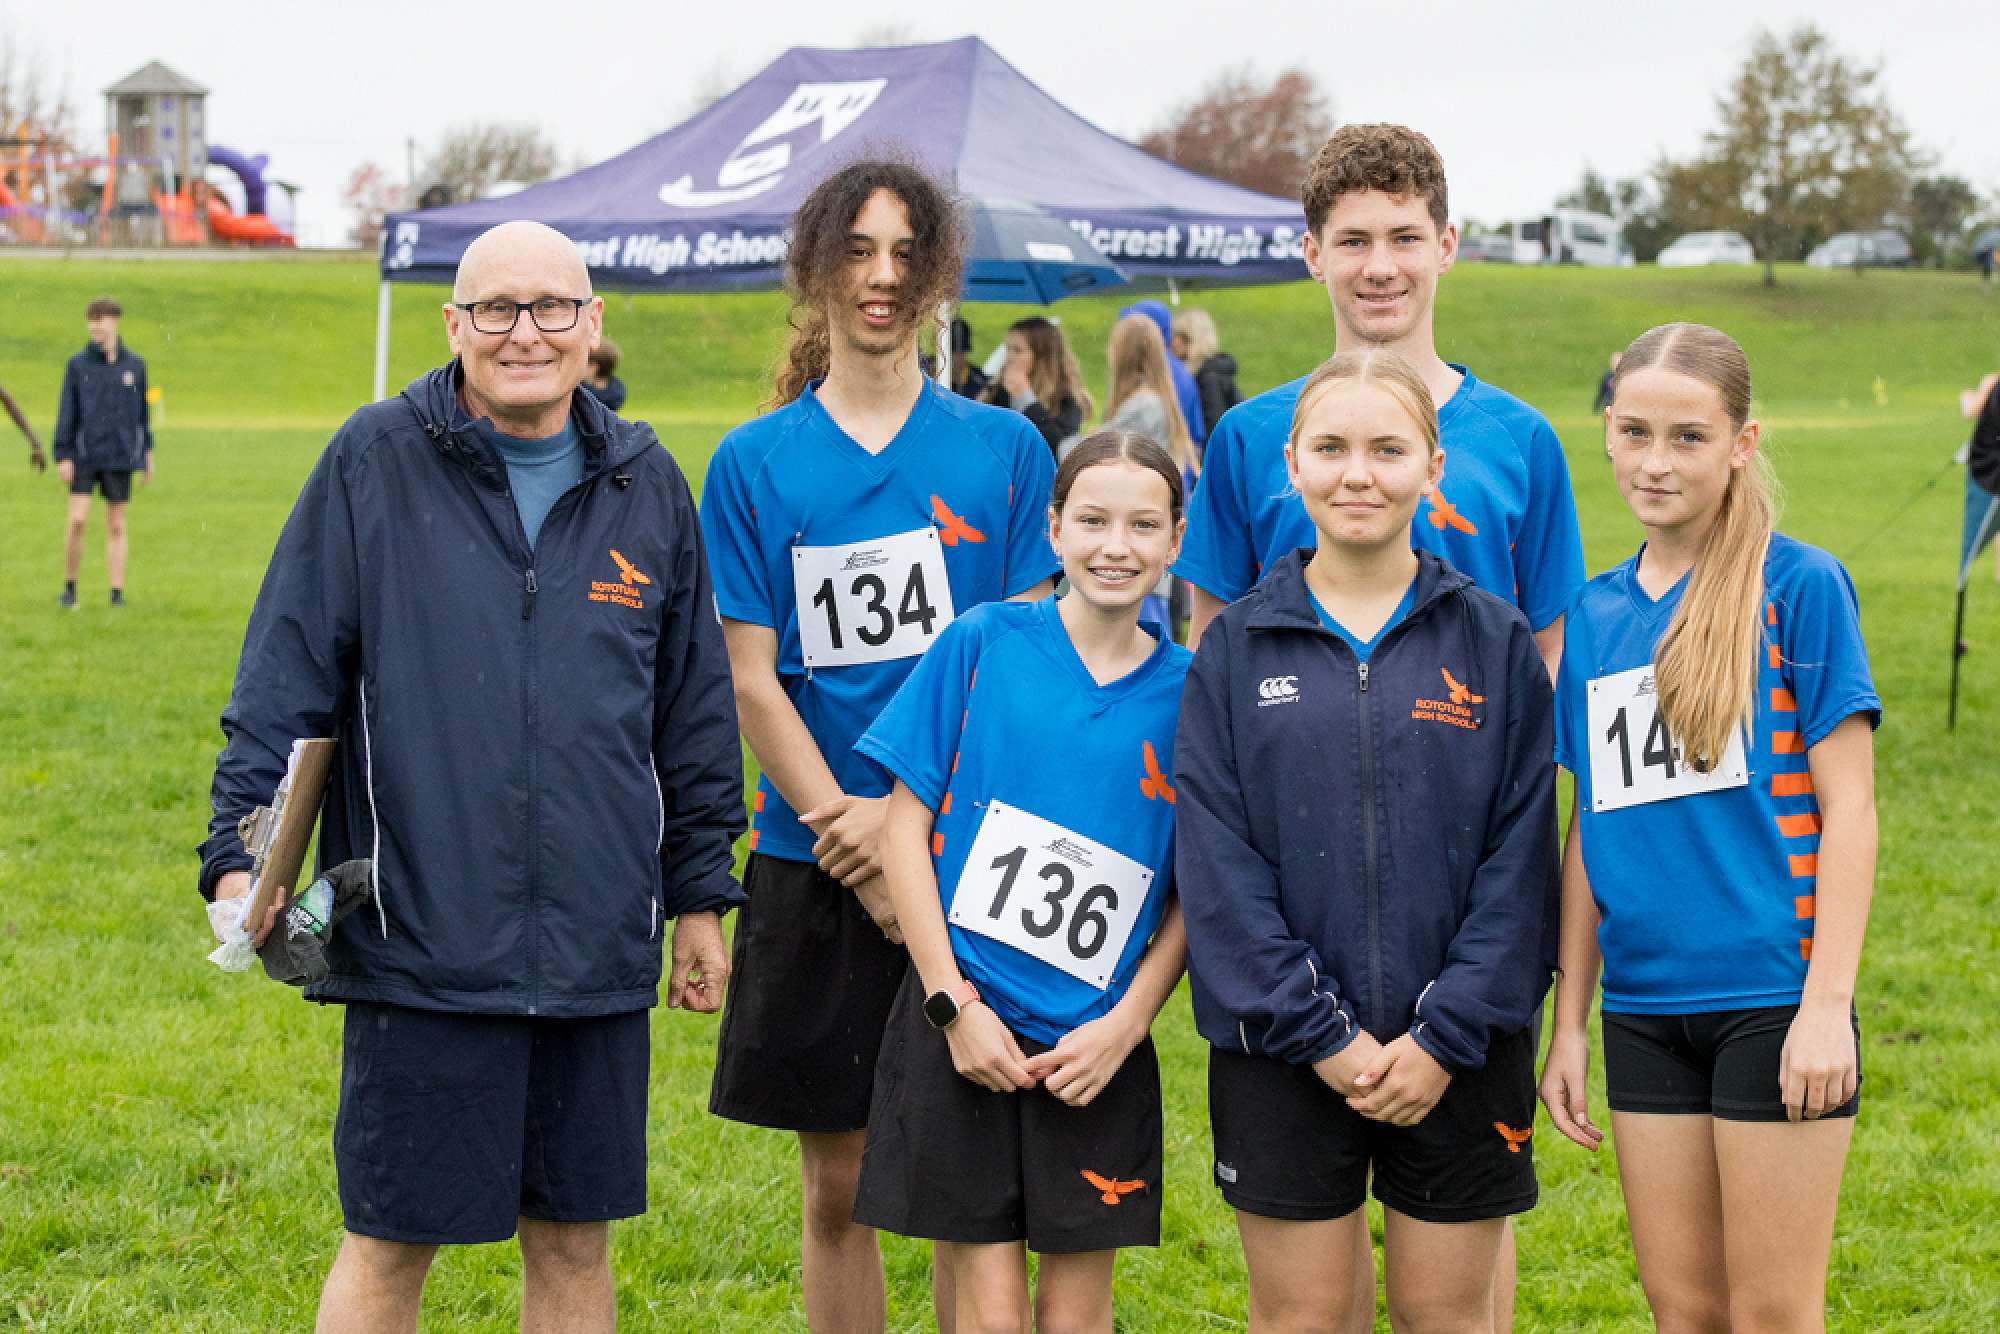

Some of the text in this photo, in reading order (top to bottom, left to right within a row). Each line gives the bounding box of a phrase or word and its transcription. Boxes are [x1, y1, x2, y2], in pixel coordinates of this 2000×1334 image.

[621, 233, 691, 275] High
[1186, 224, 1263, 265] High
[813, 561, 937, 649] 134
[988, 845, 1119, 960] 136
